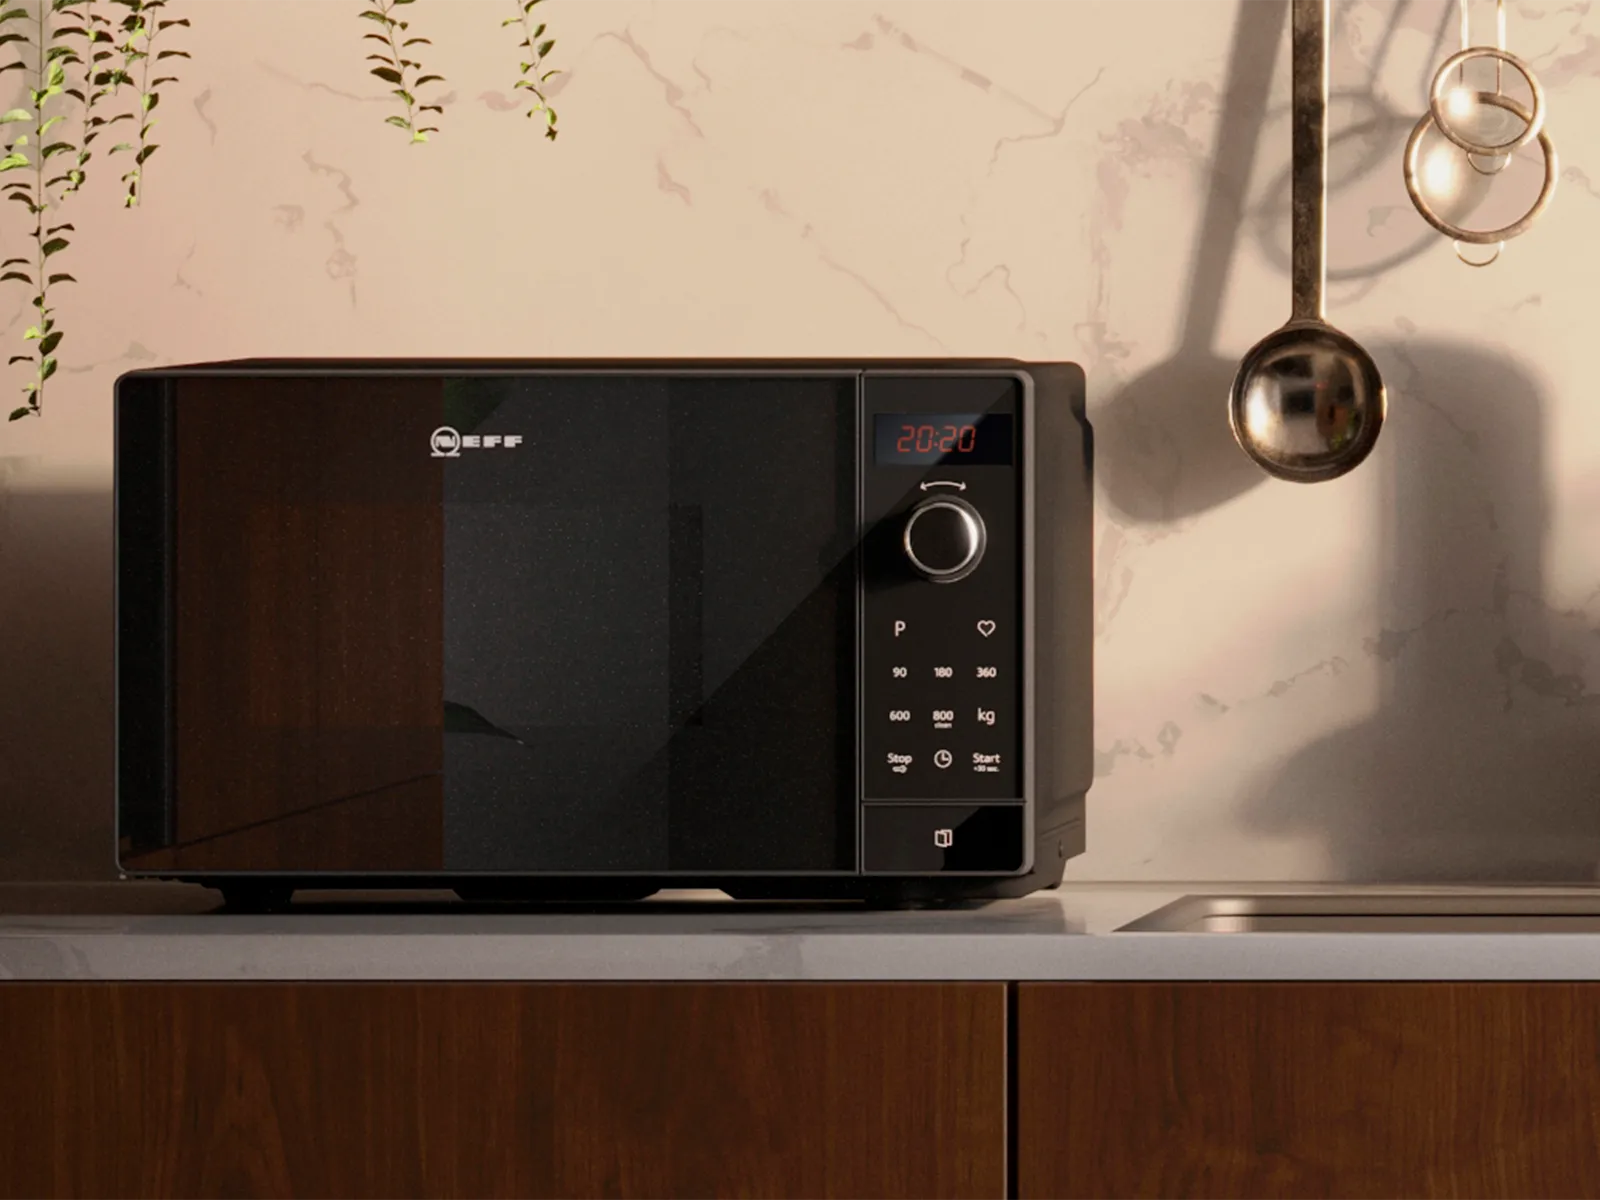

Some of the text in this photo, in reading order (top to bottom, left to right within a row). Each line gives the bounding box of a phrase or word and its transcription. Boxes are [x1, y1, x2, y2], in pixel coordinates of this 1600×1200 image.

[430, 426, 523, 457] NEFF
[897, 425, 976, 452] 20:20
[894, 620, 906, 637] P
[892, 666, 908, 678] 90
[933, 666, 953, 678] 180
[976, 666, 997, 678] 360
[889, 710, 911, 721] 600
[932, 710, 954, 721] 800
[977, 707, 996, 726] kg
[887, 752, 913, 766] Stop
[972, 752, 1001, 764] Start
